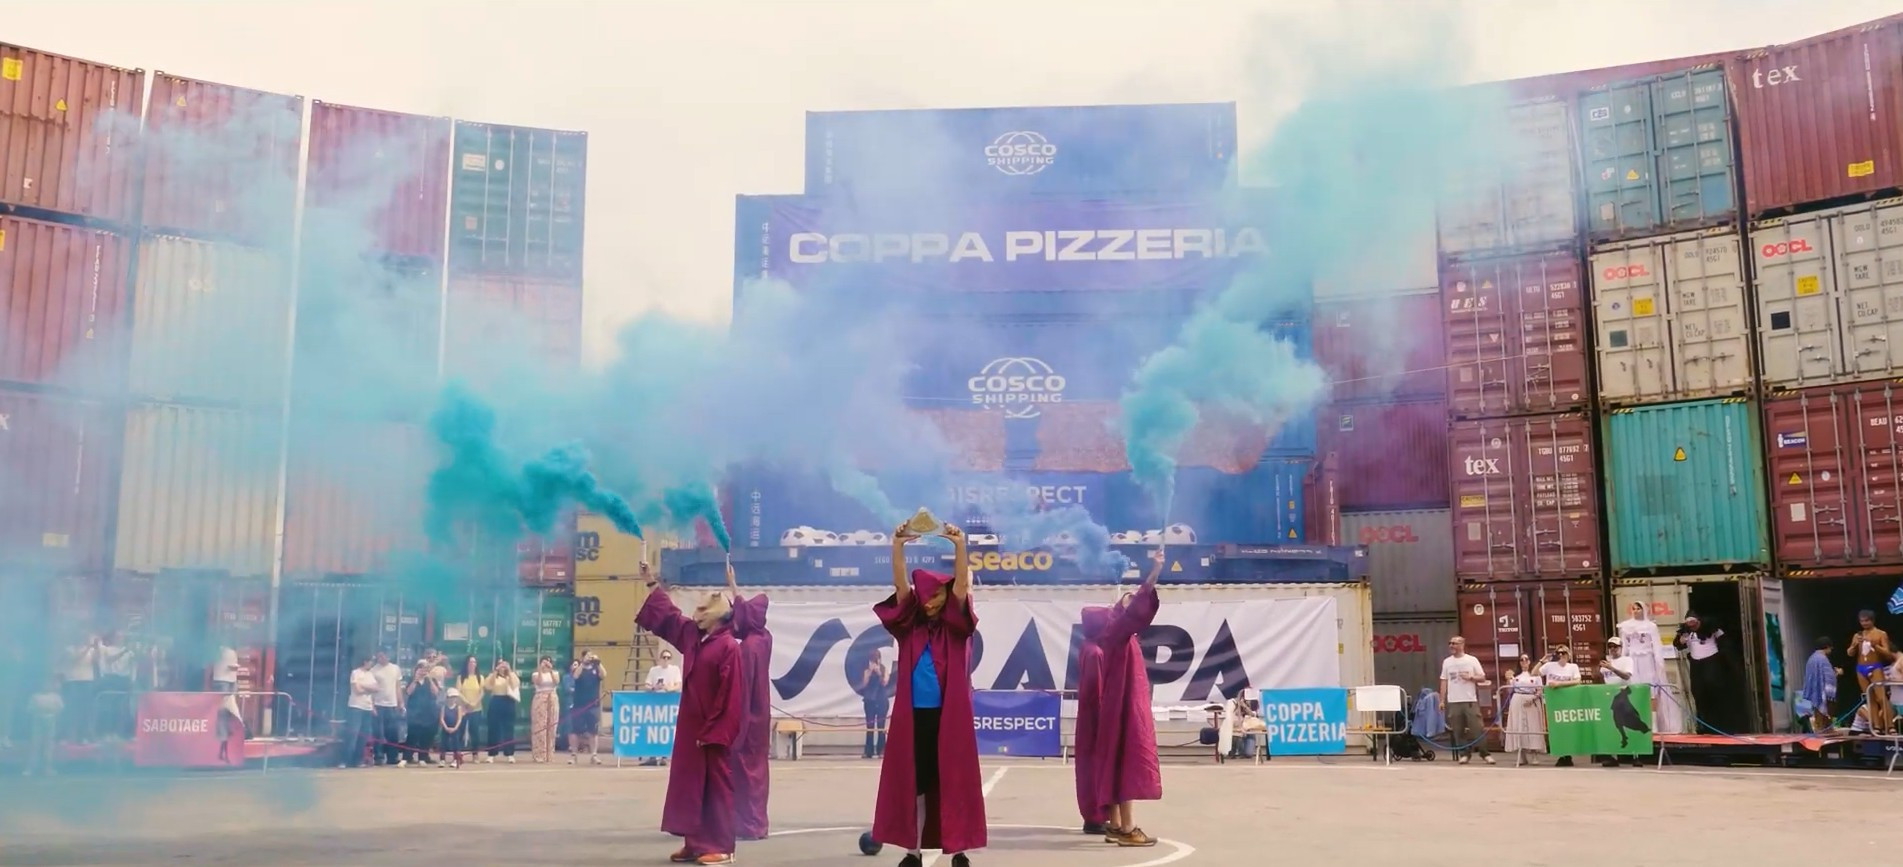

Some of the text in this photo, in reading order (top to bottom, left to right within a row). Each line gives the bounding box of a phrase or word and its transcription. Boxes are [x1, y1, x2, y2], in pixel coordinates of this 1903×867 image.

[1752, 65, 1802, 88] tex
[985, 144, 1057, 157] COSCO
[987, 157, 1054, 165] SHIPPING
[789, 232, 994, 263] COPPA
[1005, 227, 1270, 262] PIZZERIA
[1762, 239, 1813, 258] OOCL
[1603, 263, 1650, 281] OOCL
[968, 375, 1066, 392] COSCO
[972, 393, 1062, 404] SHIPPING
[1464, 455, 1501, 475] tex
[1360, 524, 1419, 544] OOCL
[968, 551, 1054, 571] seaco
[1572, 623, 1586, 631] 45G1
[1373, 634, 1427, 653] OOCL
[771, 617, 1252, 701] SCAPA
[620, 704, 680, 724] CHAMP
[1266, 702, 1325, 722] COPPA
[1554, 708, 1601, 723] DECEIVE
[143, 719, 208, 732] SABOTAGE
[619, 726, 640, 744] OF
[1268, 722, 1347, 743] PIZZERIA
